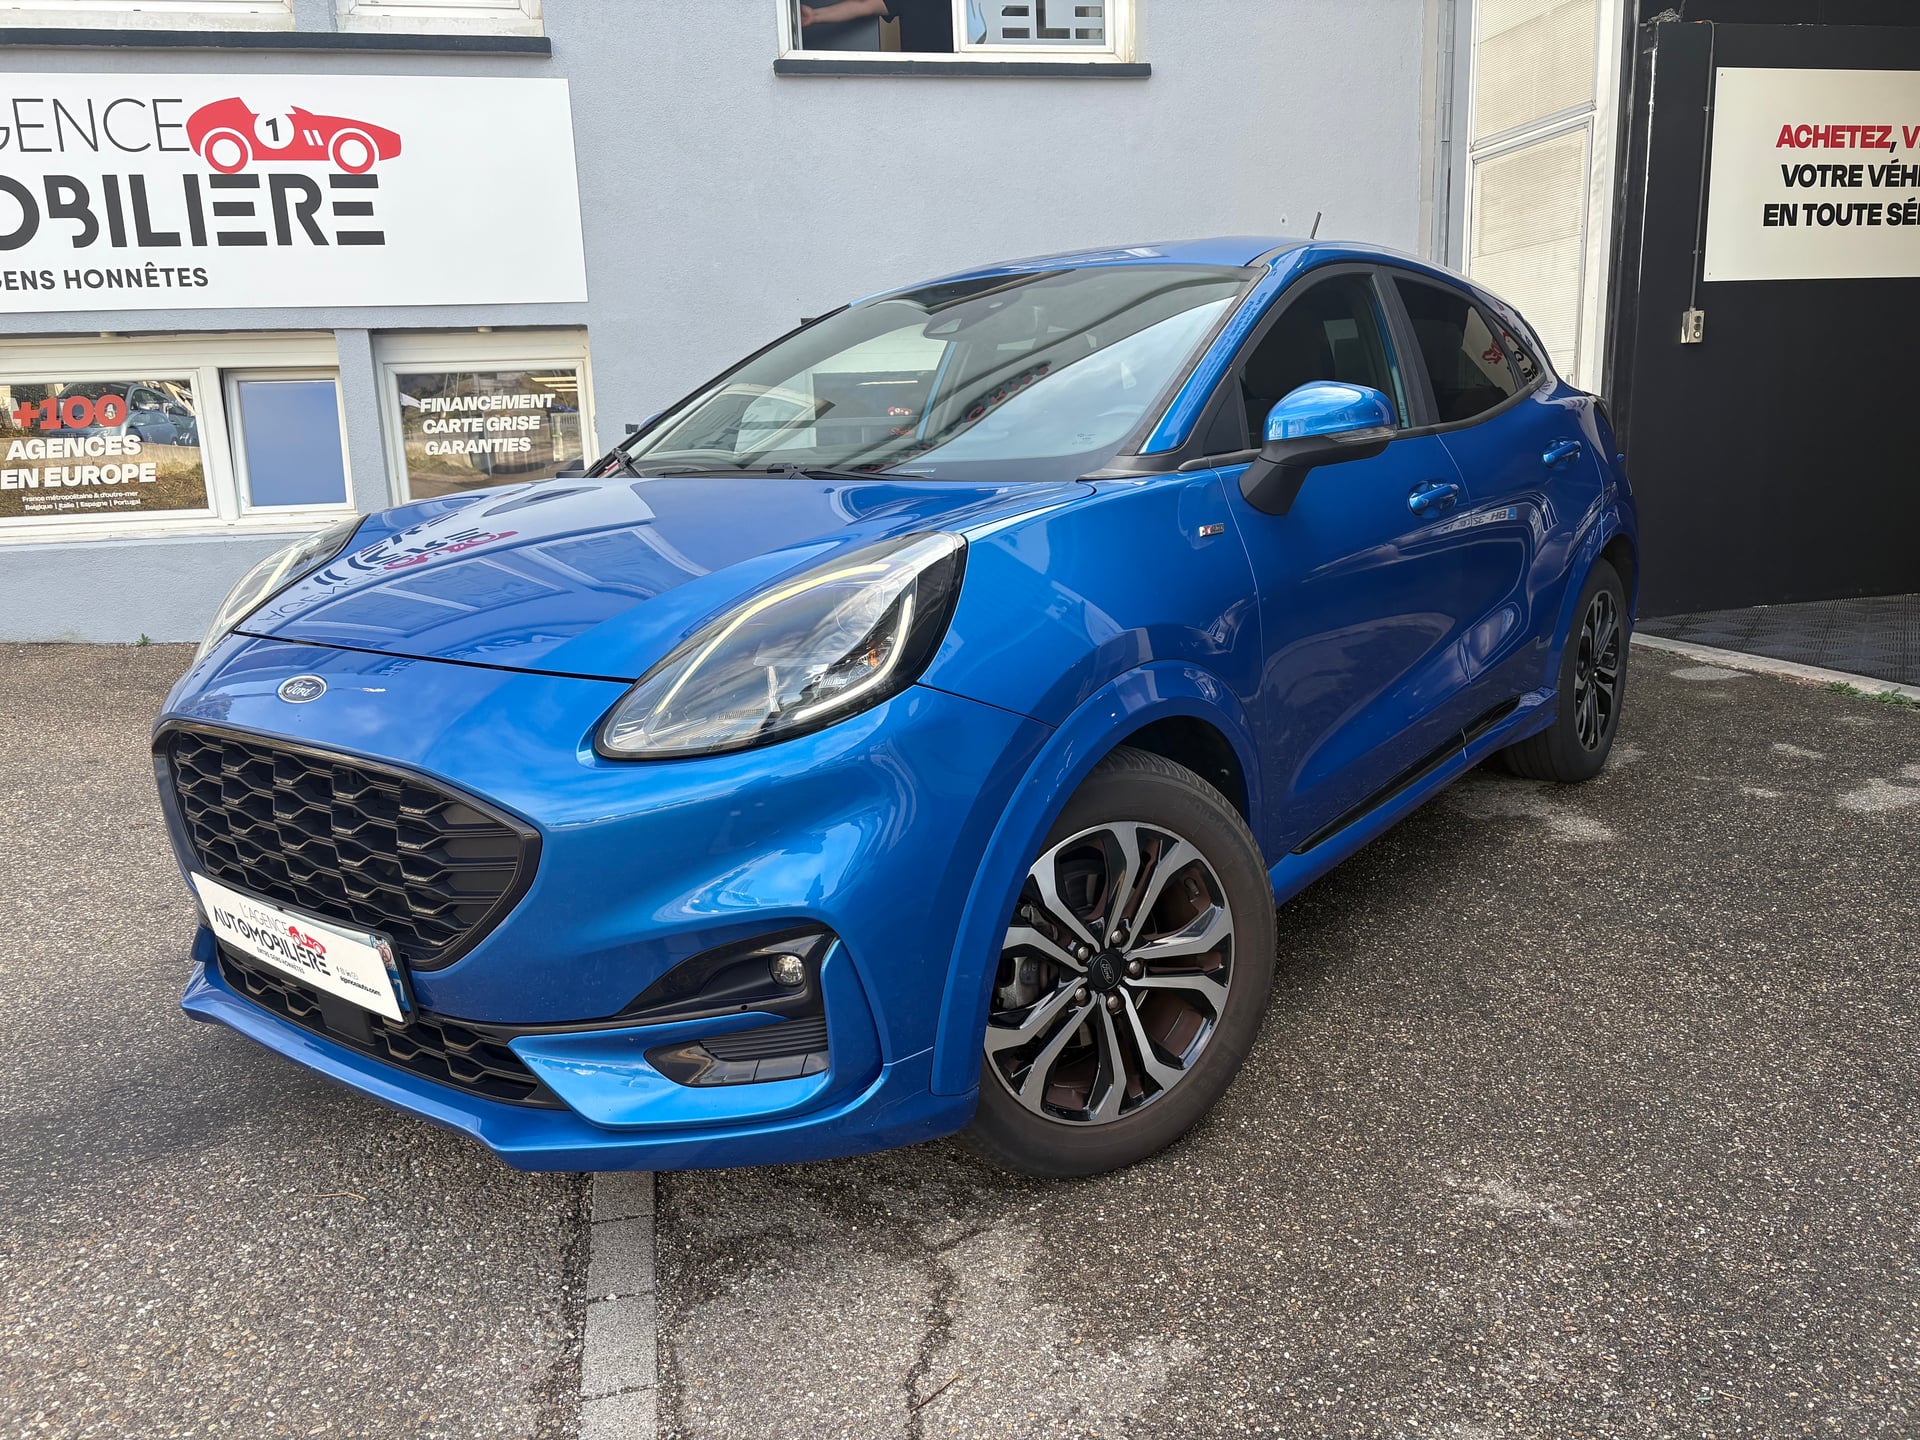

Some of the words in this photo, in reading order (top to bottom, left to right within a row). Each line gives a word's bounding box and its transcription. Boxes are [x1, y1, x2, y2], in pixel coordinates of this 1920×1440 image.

[0, 98, 190, 152] ENCE
[266, 119, 280, 142] 1
[1776, 124, 1897, 153] ACHETEZ,
[1902, 125, 1920, 149] V
[1781, 164, 1864, 188] VOTRE
[1763, 203, 1798, 227] EN
[1802, 203, 1883, 227] TOUTE
[0, 270, 55, 290] ENS
[63, 262, 208, 290] HONNÊTES
[13, 394, 127, 430] +100
[420, 393, 556, 413] FINANCEMENT
[423, 417, 484, 434] CARTE
[486, 415, 541, 432] GRISE
[6, 435, 142, 461] AGENCES
[425, 437, 531, 455] GARANTIES
[0, 468, 38, 490] EN
[44, 463, 156, 487] EUROPE
[285, 680, 317, 697] Ford
